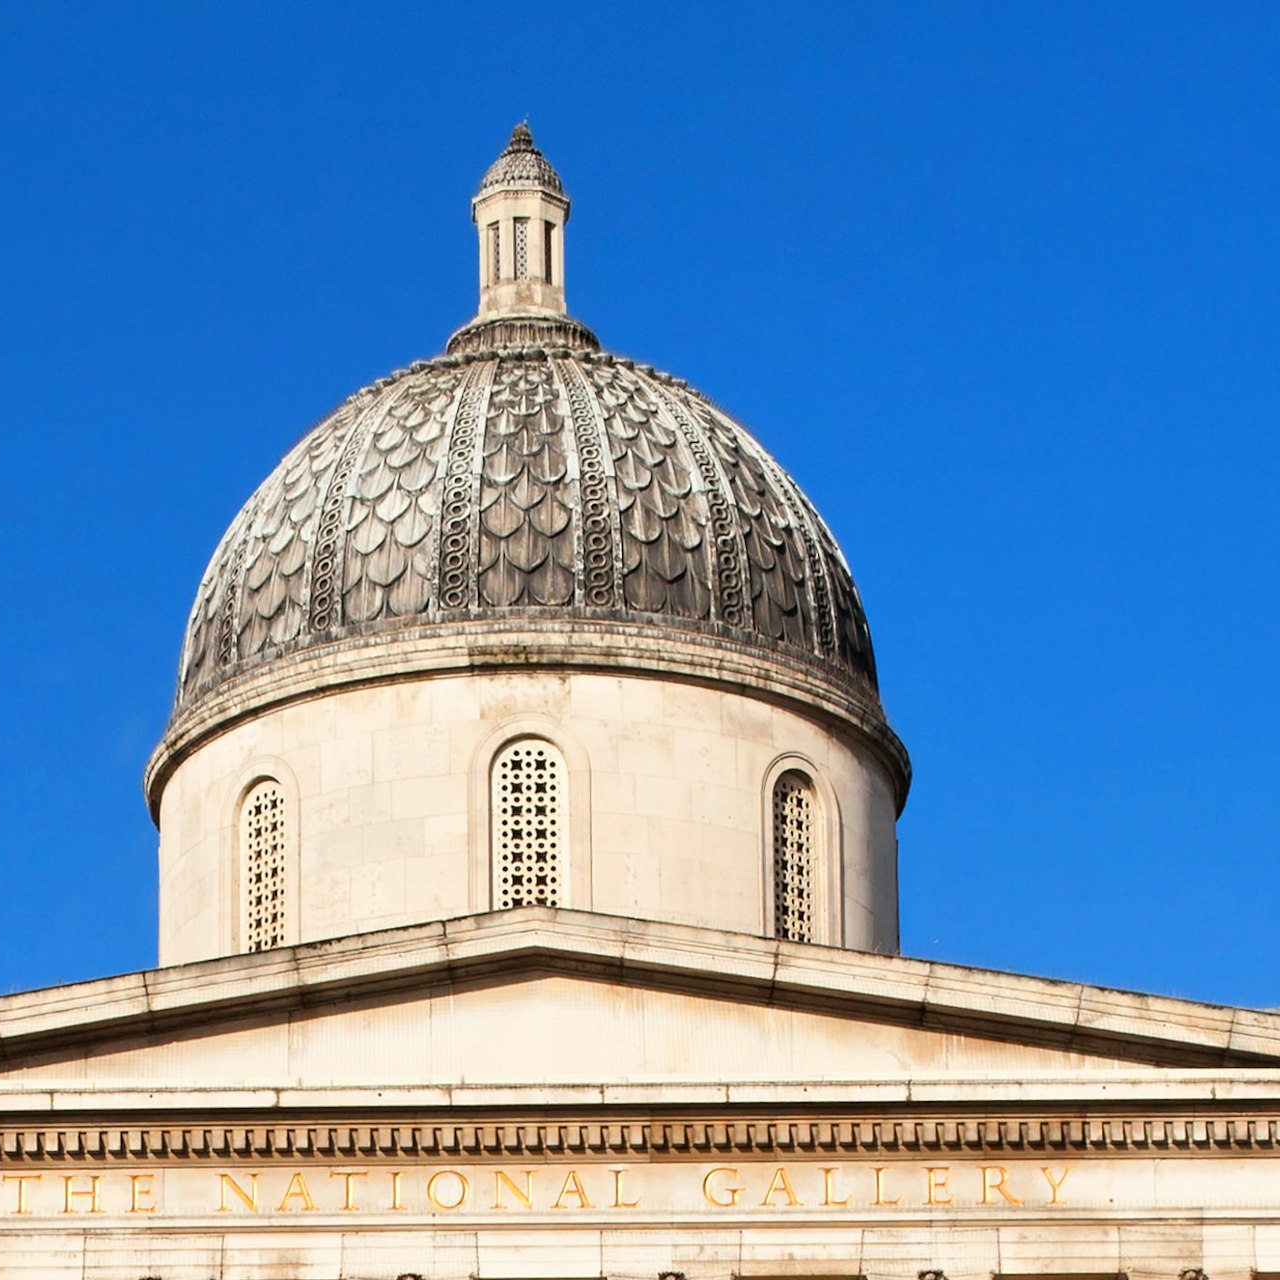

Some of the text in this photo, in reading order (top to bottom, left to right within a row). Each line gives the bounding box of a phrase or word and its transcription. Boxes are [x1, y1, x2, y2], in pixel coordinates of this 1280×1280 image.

[1, 1165, 1077, 1215] THE NATIONAL GALLERY
